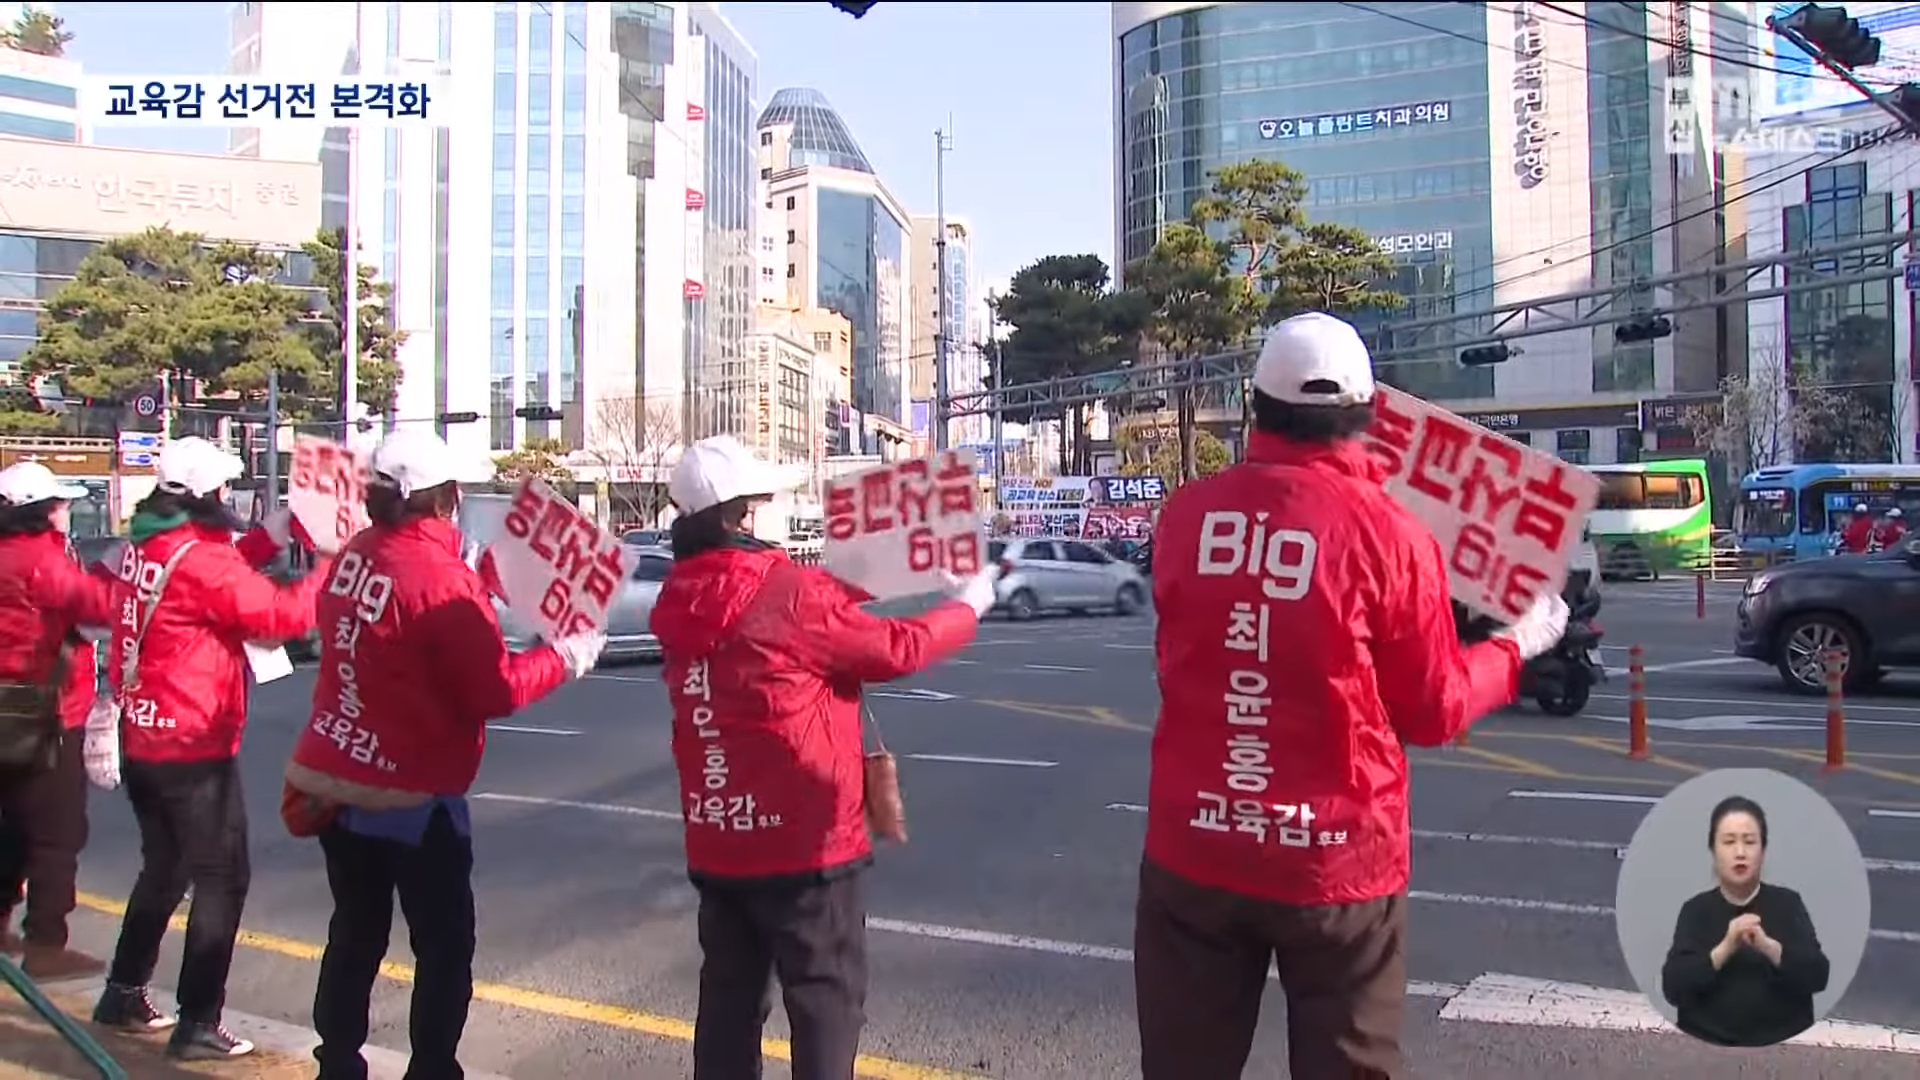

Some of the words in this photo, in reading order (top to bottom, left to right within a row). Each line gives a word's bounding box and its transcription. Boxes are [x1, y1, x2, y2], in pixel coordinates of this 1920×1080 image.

[92, 171, 242, 219] 한국투자
[1370, 230, 1453, 255] 성모안과
[140, 399, 155, 412] 50
[1107, 477, 1162, 500] 김석준
[120, 541, 165, 604] Big
[1196, 510, 1318, 601] Big
[329, 550, 394, 624] Big
[1222, 602, 1275, 794] 최윤홍
[312, 711, 379, 764] 교육감
[688, 792, 756, 832] 교육감
[1190, 790, 1317, 848] 교육감
[1316, 829, 1349, 846] 후보
